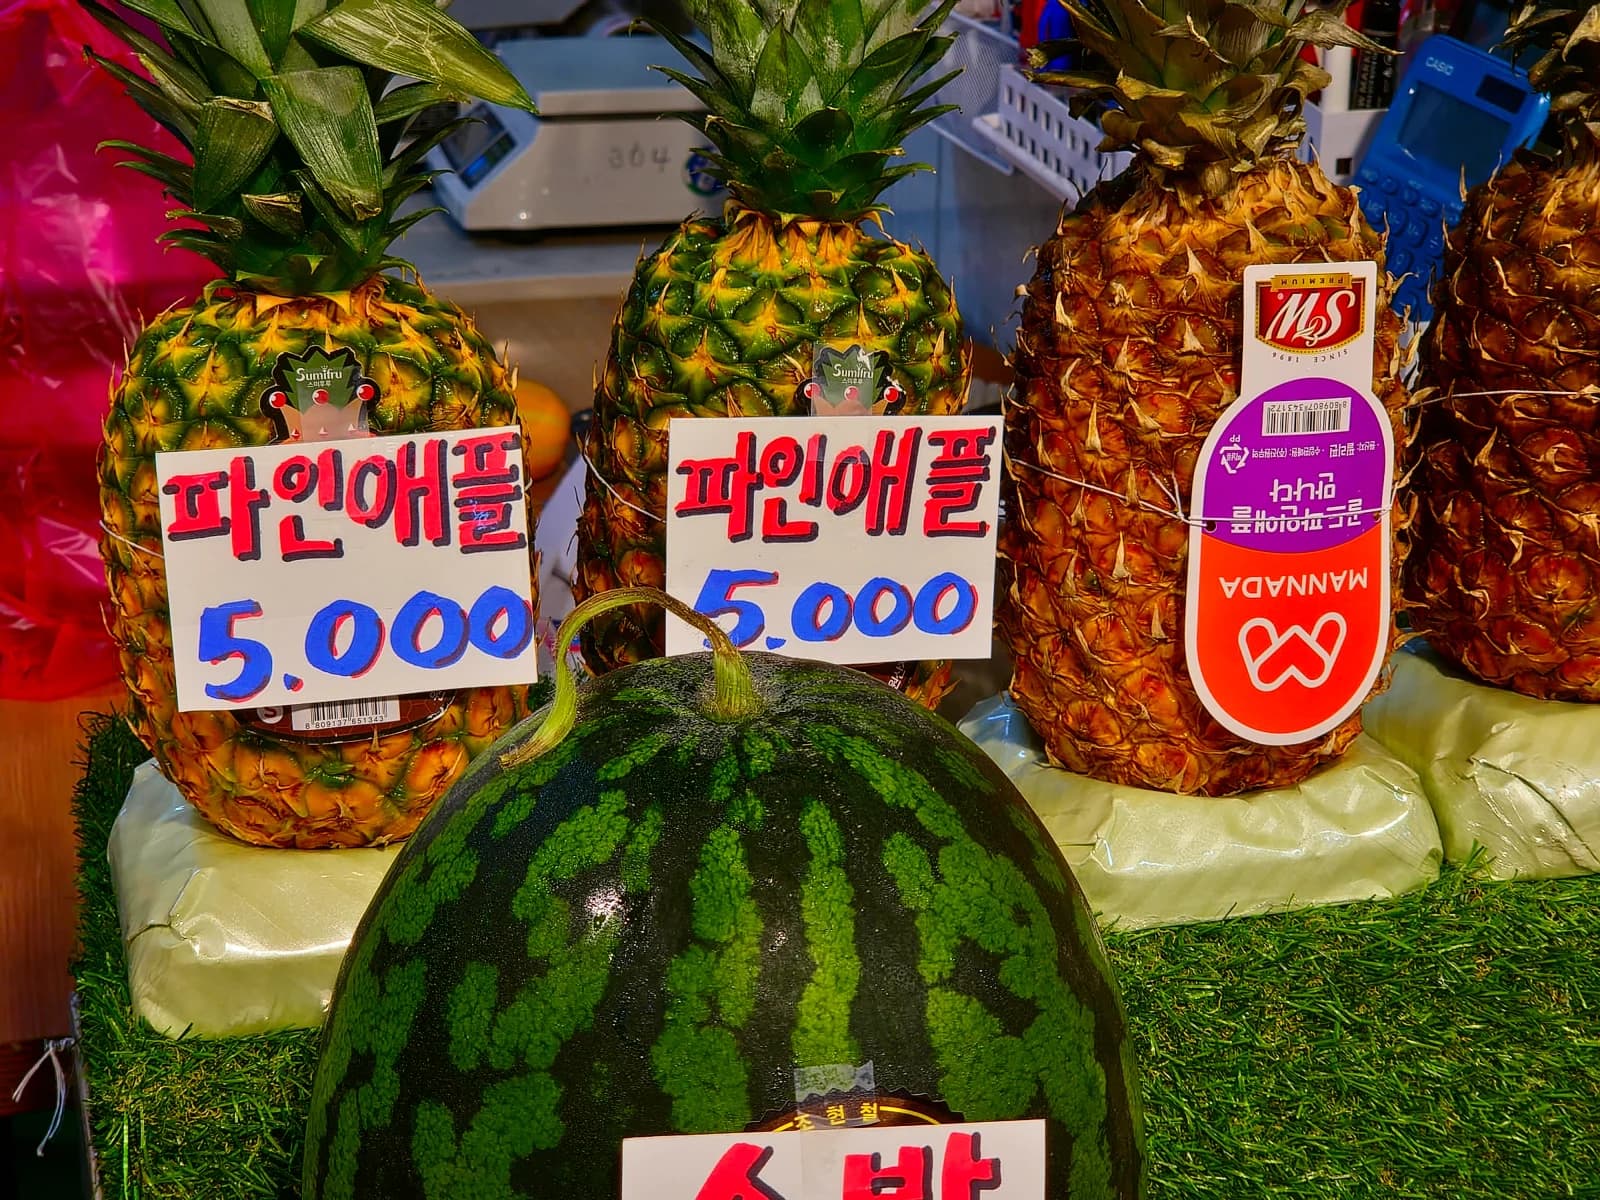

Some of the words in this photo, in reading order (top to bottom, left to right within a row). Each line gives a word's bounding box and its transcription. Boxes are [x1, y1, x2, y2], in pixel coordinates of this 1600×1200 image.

[1281, 277, 1344, 285] PREMIUM
[1272, 351, 1299, 363] 1896
[1313, 349, 1348, 363] SINCE
[296, 365, 343, 382] Sumifru
[832, 363, 873, 378] Sumifru
[674, 426, 997, 544] 파인애플
[1269, 473, 1336, 503] 만나다
[162, 432, 527, 562] 파인애플
[1219, 567, 1368, 598] MANNADA
[199, 585, 534, 702] 5.000
[315, 719, 347, 728] 809137
